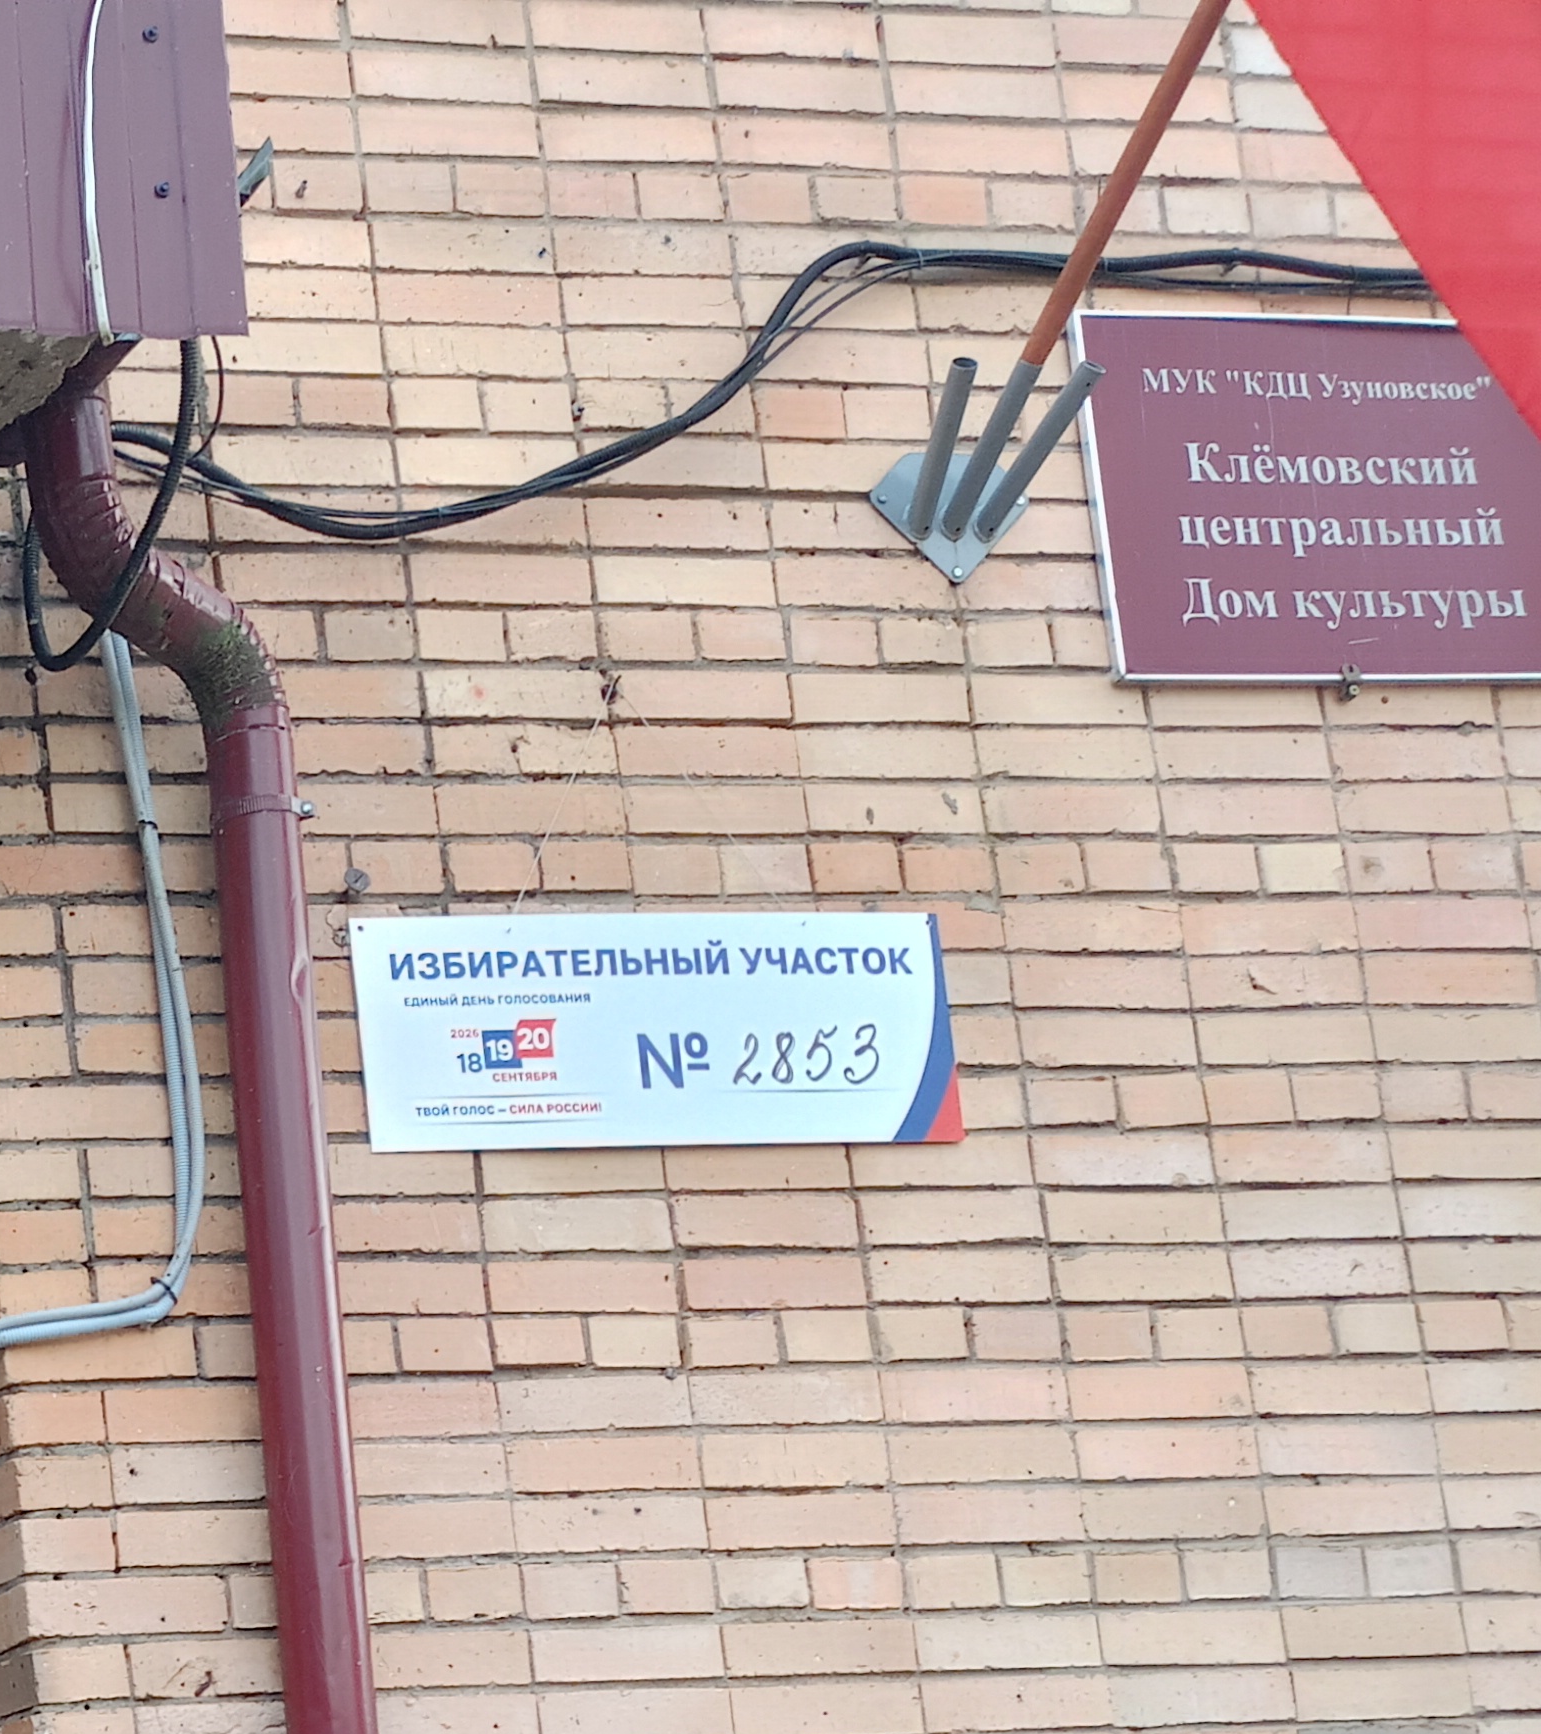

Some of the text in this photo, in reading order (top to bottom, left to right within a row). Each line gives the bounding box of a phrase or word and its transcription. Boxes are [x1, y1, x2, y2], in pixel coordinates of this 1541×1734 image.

[1141, 367, 1493, 406] МУК "КДЦ Узуновское"
[1184, 442, 1479, 486] Клёмовский
[1178, 507, 1505, 558] центральный
[1182, 577, 1528, 630] Дом культуры
[388, 939, 913, 980] ИЗБИРАТЕЛЬНЫЙ УЧАСТОК
[404, 992, 592, 1007] ЕДИНЫЙ ДЕНЬ ГОЛОСОВАНИЯ
[456, 1027, 551, 1074] 18 19 20
[636, 1023, 880, 1089] № 2853
[492, 1071, 558, 1082] СЕНТЯБРЯ
[415, 1104, 450, 1117] ТВОЙ
[453, 1105, 495, 1116] ГОЛОС
[509, 1104, 544, 1115] СИЛА
[546, 1102, 603, 1114] РОССИИ!
